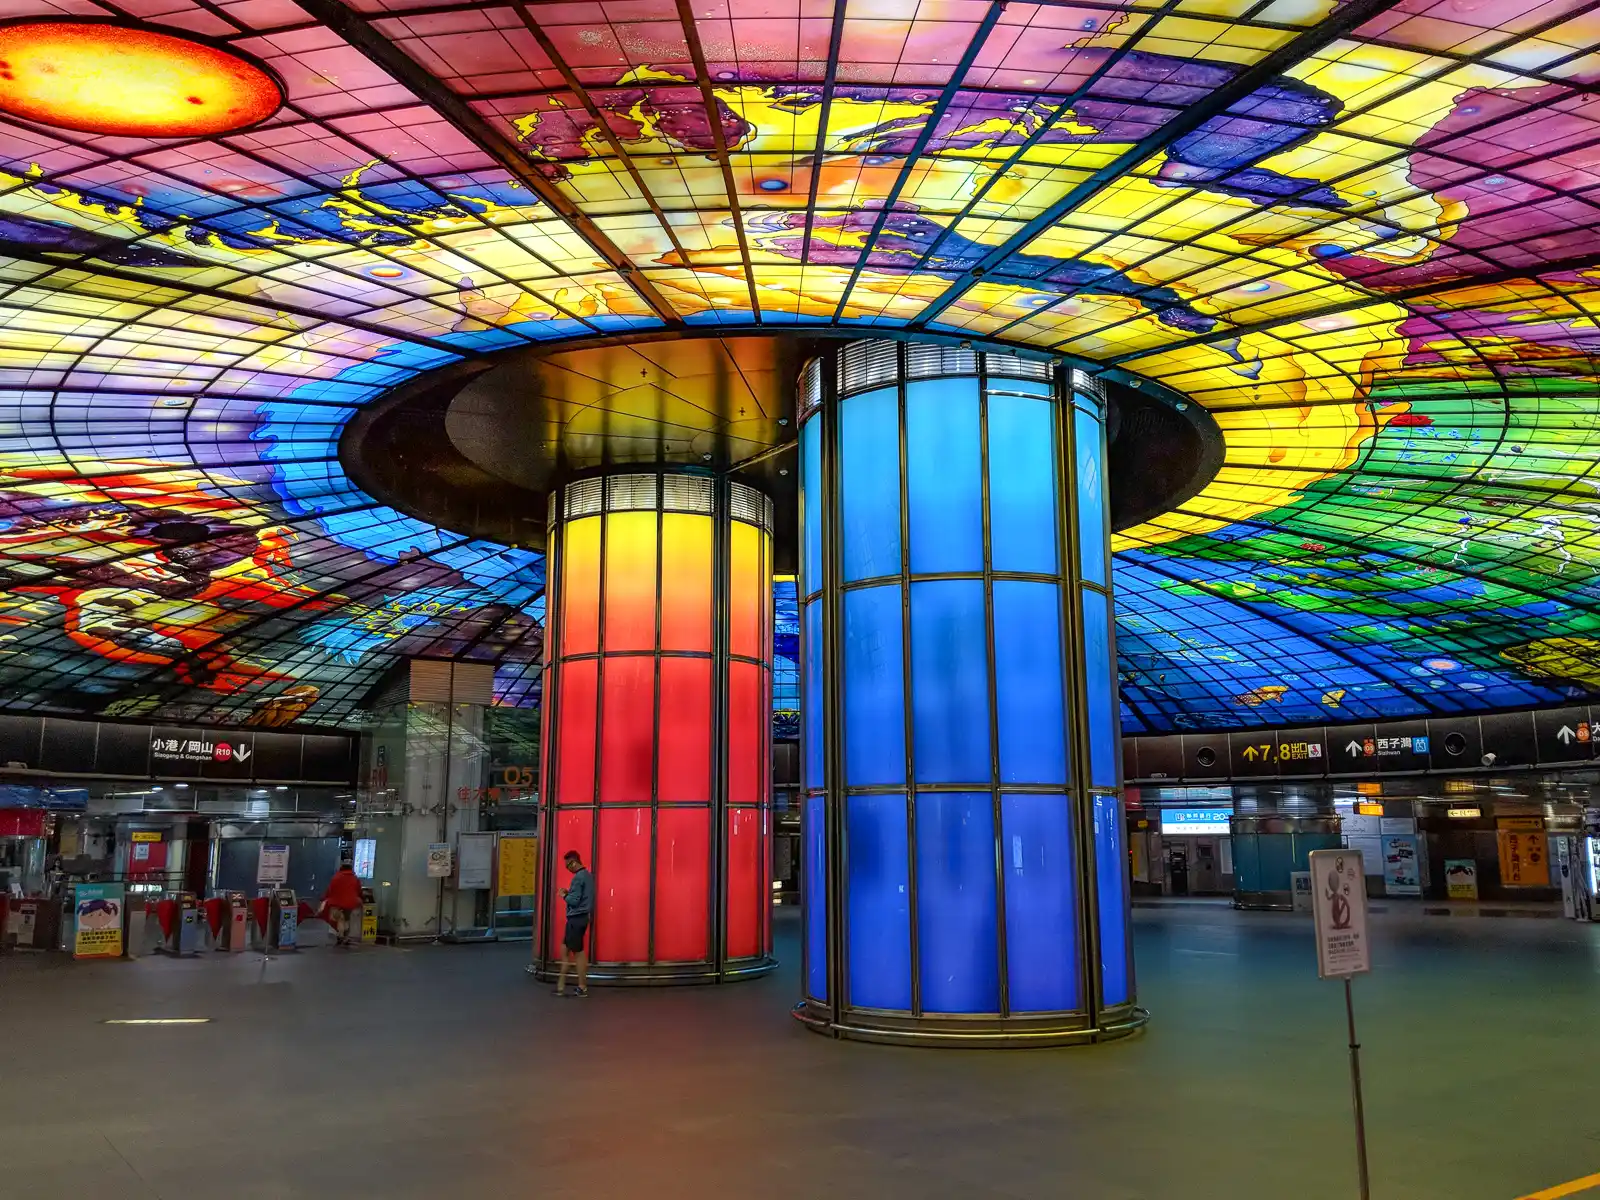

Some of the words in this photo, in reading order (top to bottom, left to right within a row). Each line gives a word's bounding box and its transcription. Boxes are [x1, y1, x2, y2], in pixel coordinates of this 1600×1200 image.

[1291, 742, 1308, 753] 出口
[1377, 737, 1412, 749] 西子灣
[154, 752, 179, 760] Siaogang
[216, 748, 231, 756] R10
